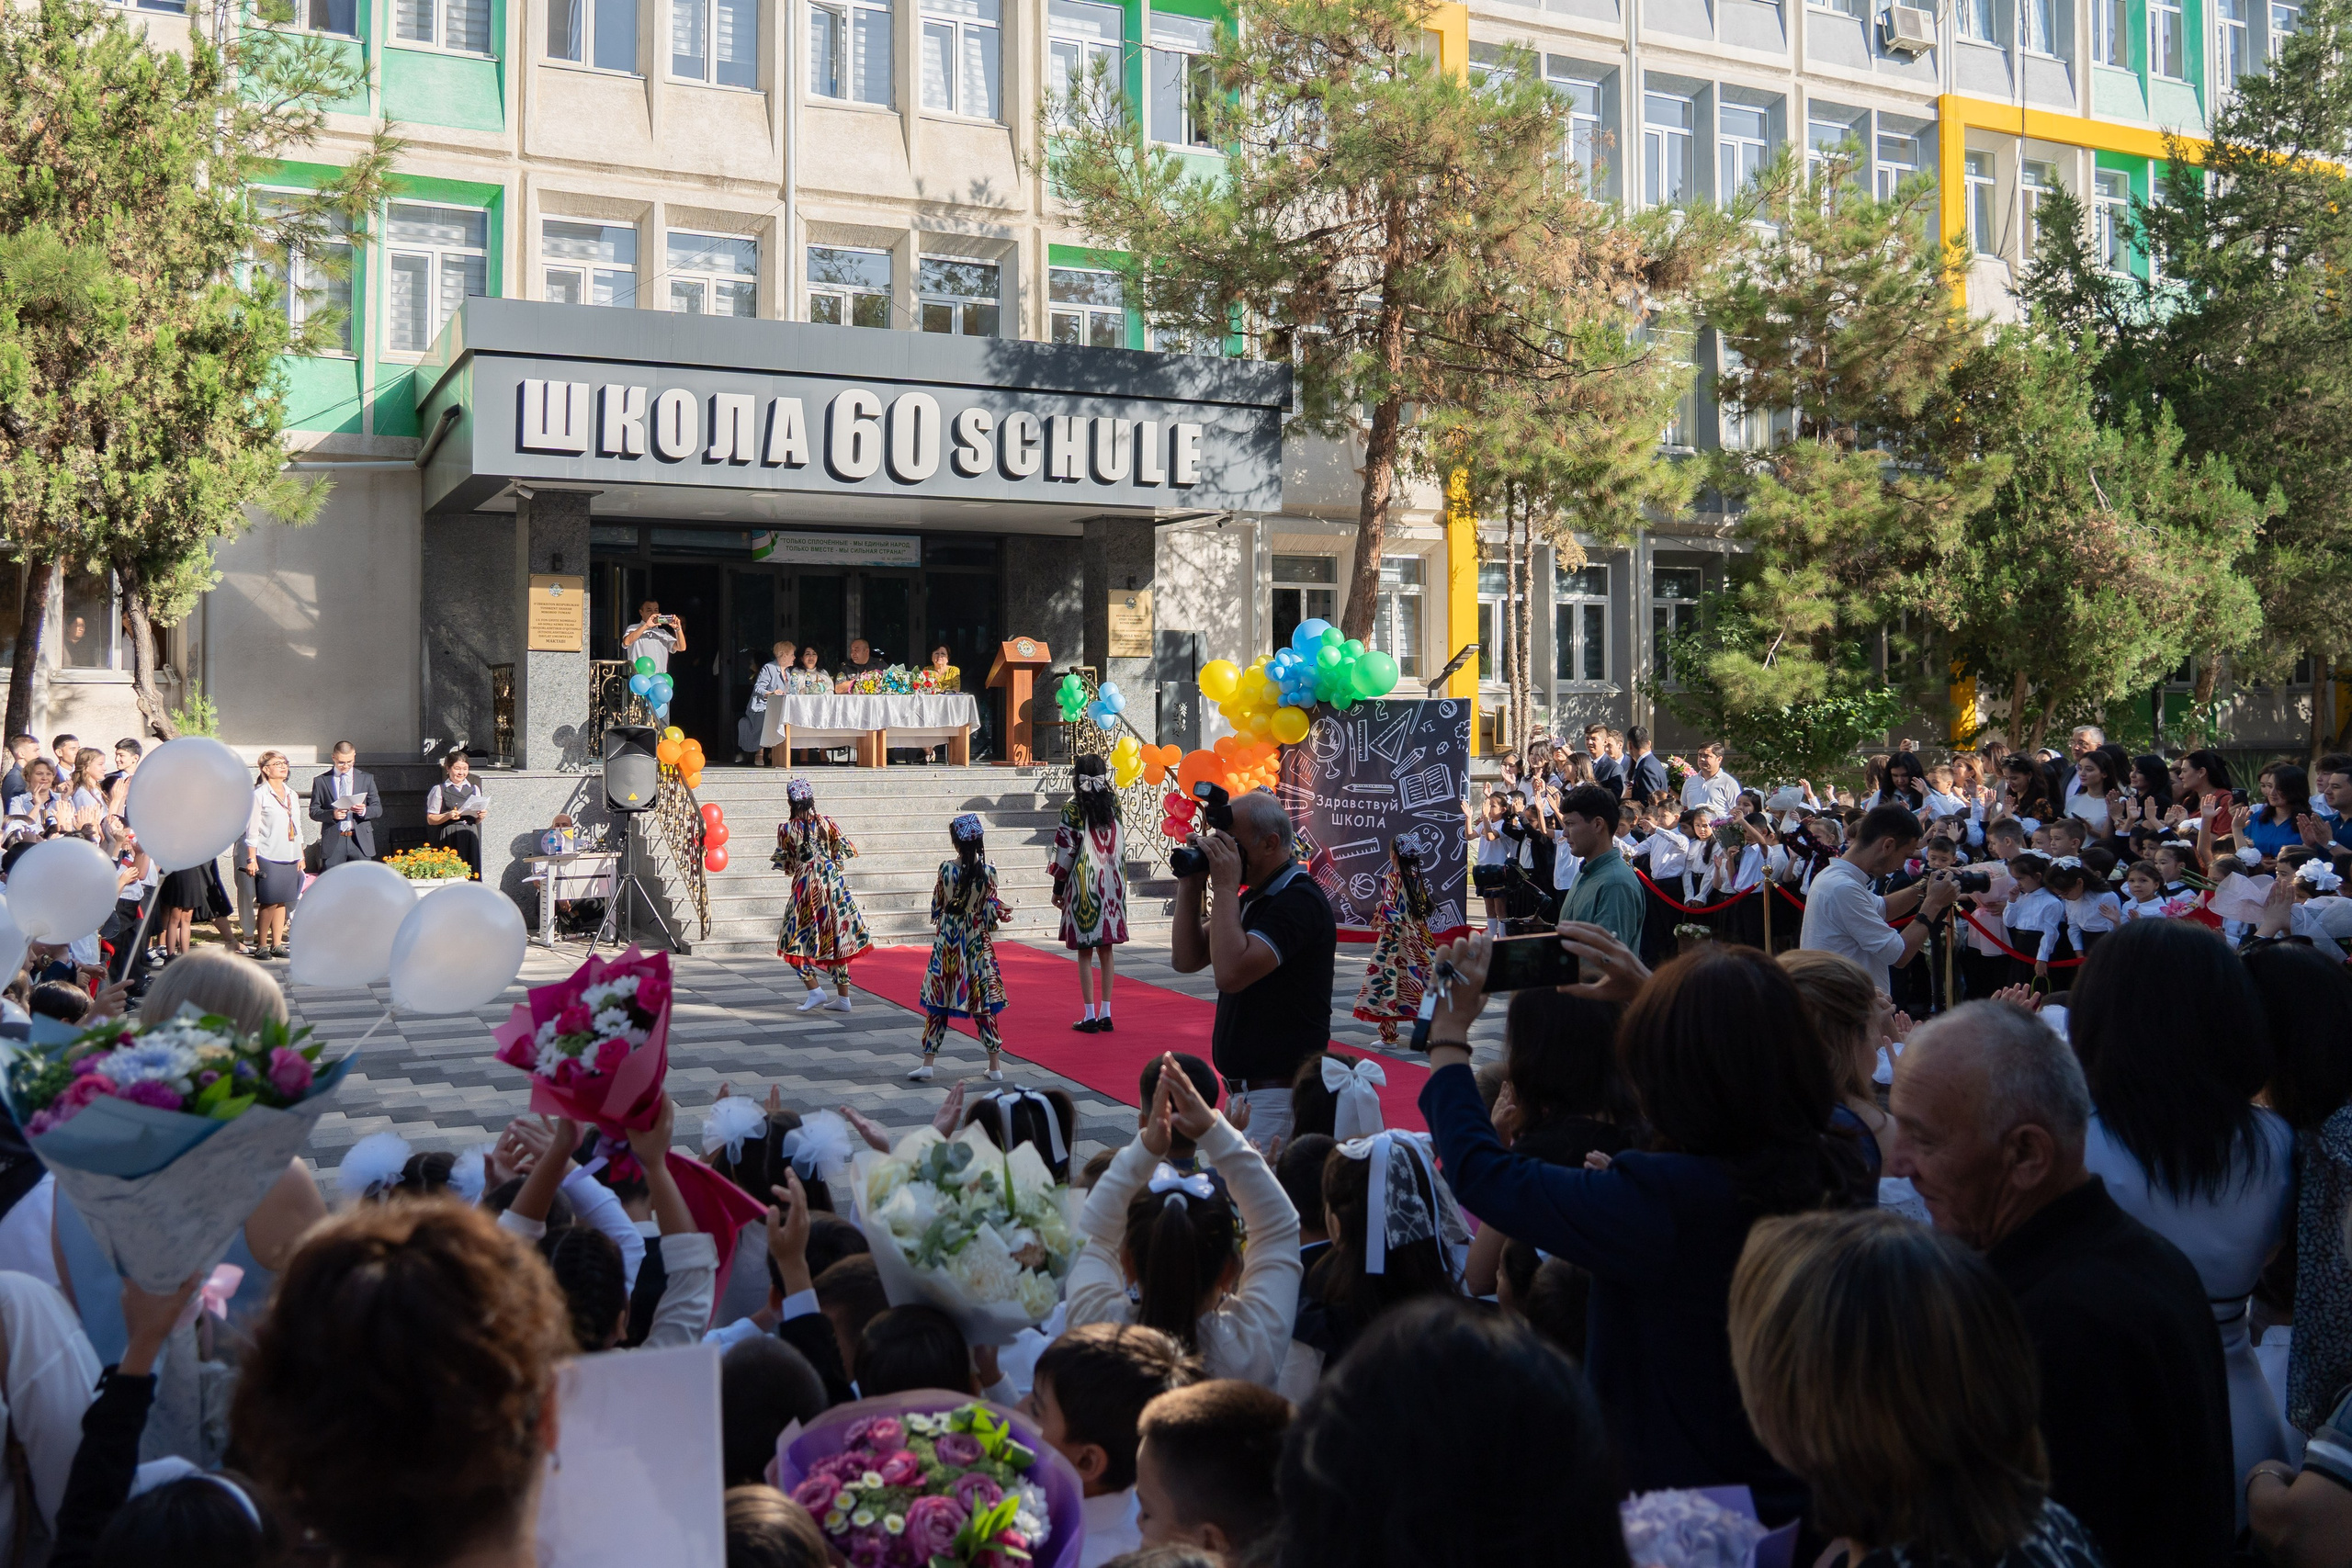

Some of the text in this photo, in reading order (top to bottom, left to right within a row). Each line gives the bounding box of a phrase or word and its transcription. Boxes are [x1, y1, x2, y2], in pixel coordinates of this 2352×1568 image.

[518, 378, 1203, 488] ШКОЛА 60 SCHULE
[1316, 795, 1404, 814] Здравствуй,
[1331, 813, 1385, 829] ШКОЛА
